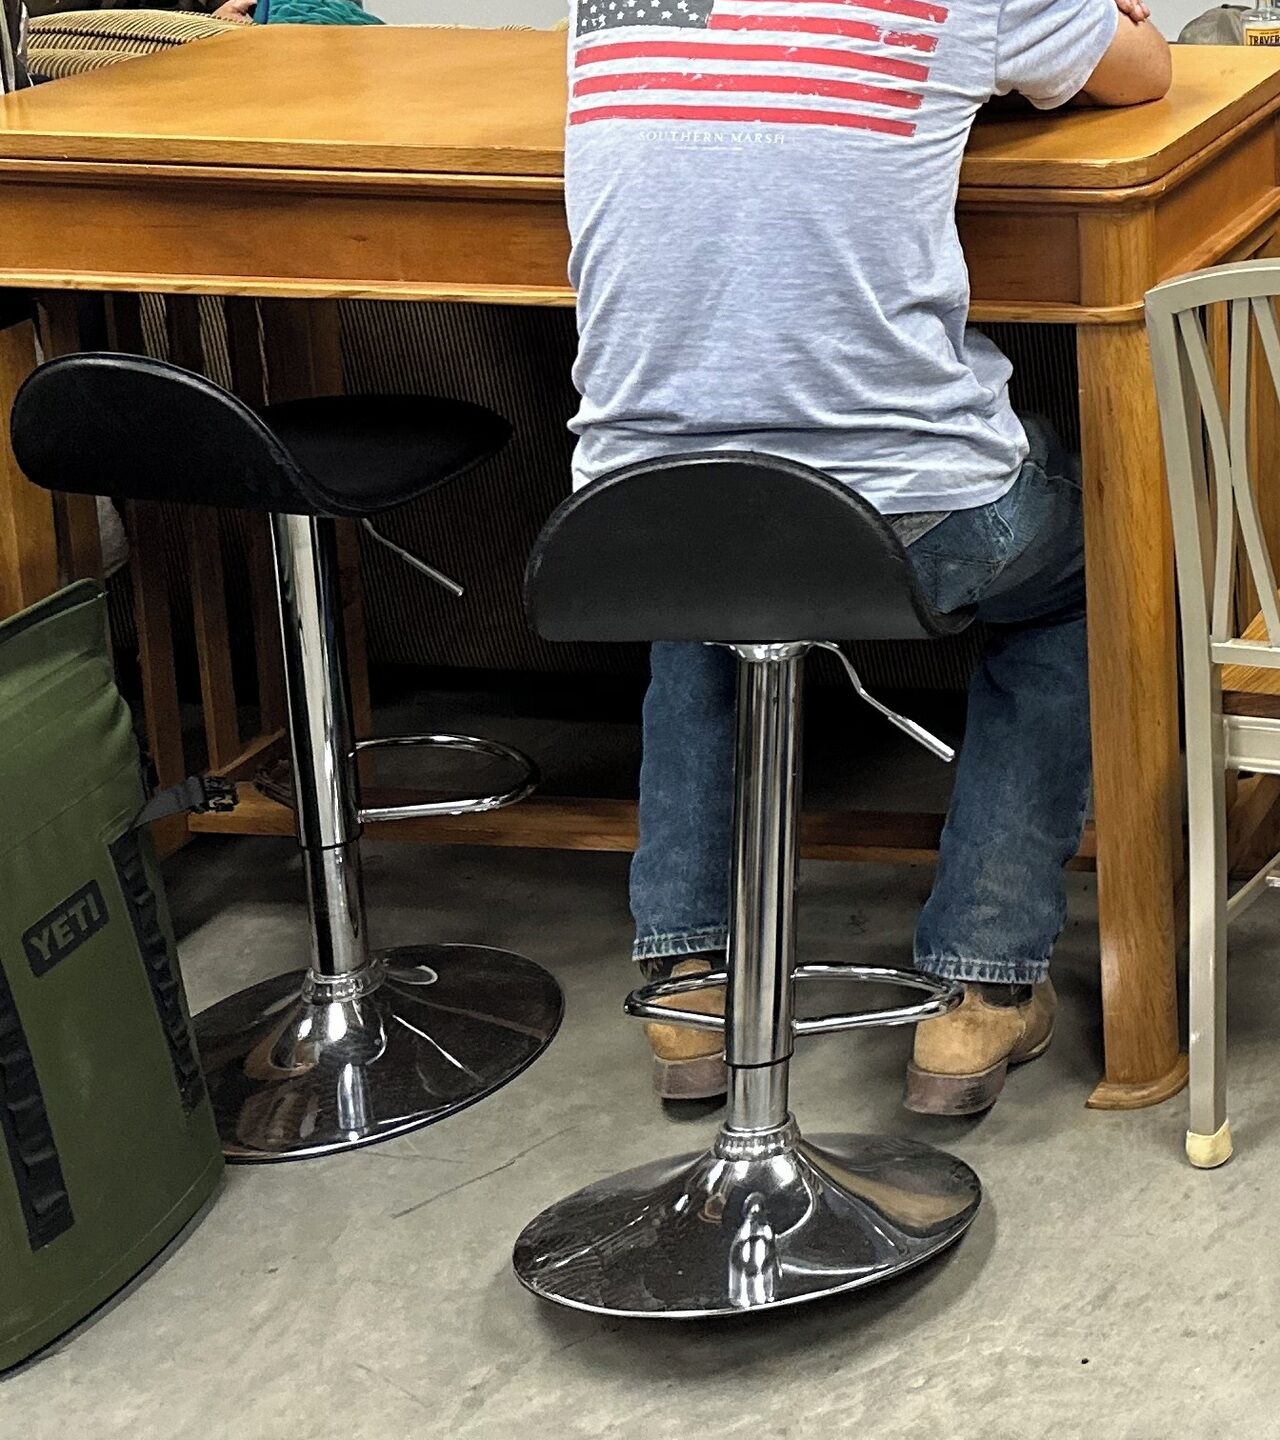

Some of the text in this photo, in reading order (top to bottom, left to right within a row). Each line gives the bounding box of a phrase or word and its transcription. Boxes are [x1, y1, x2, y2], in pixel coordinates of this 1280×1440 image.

[639, 130, 785, 145] SOUTHERN MARSH
[30, 892, 100, 961] YETI
